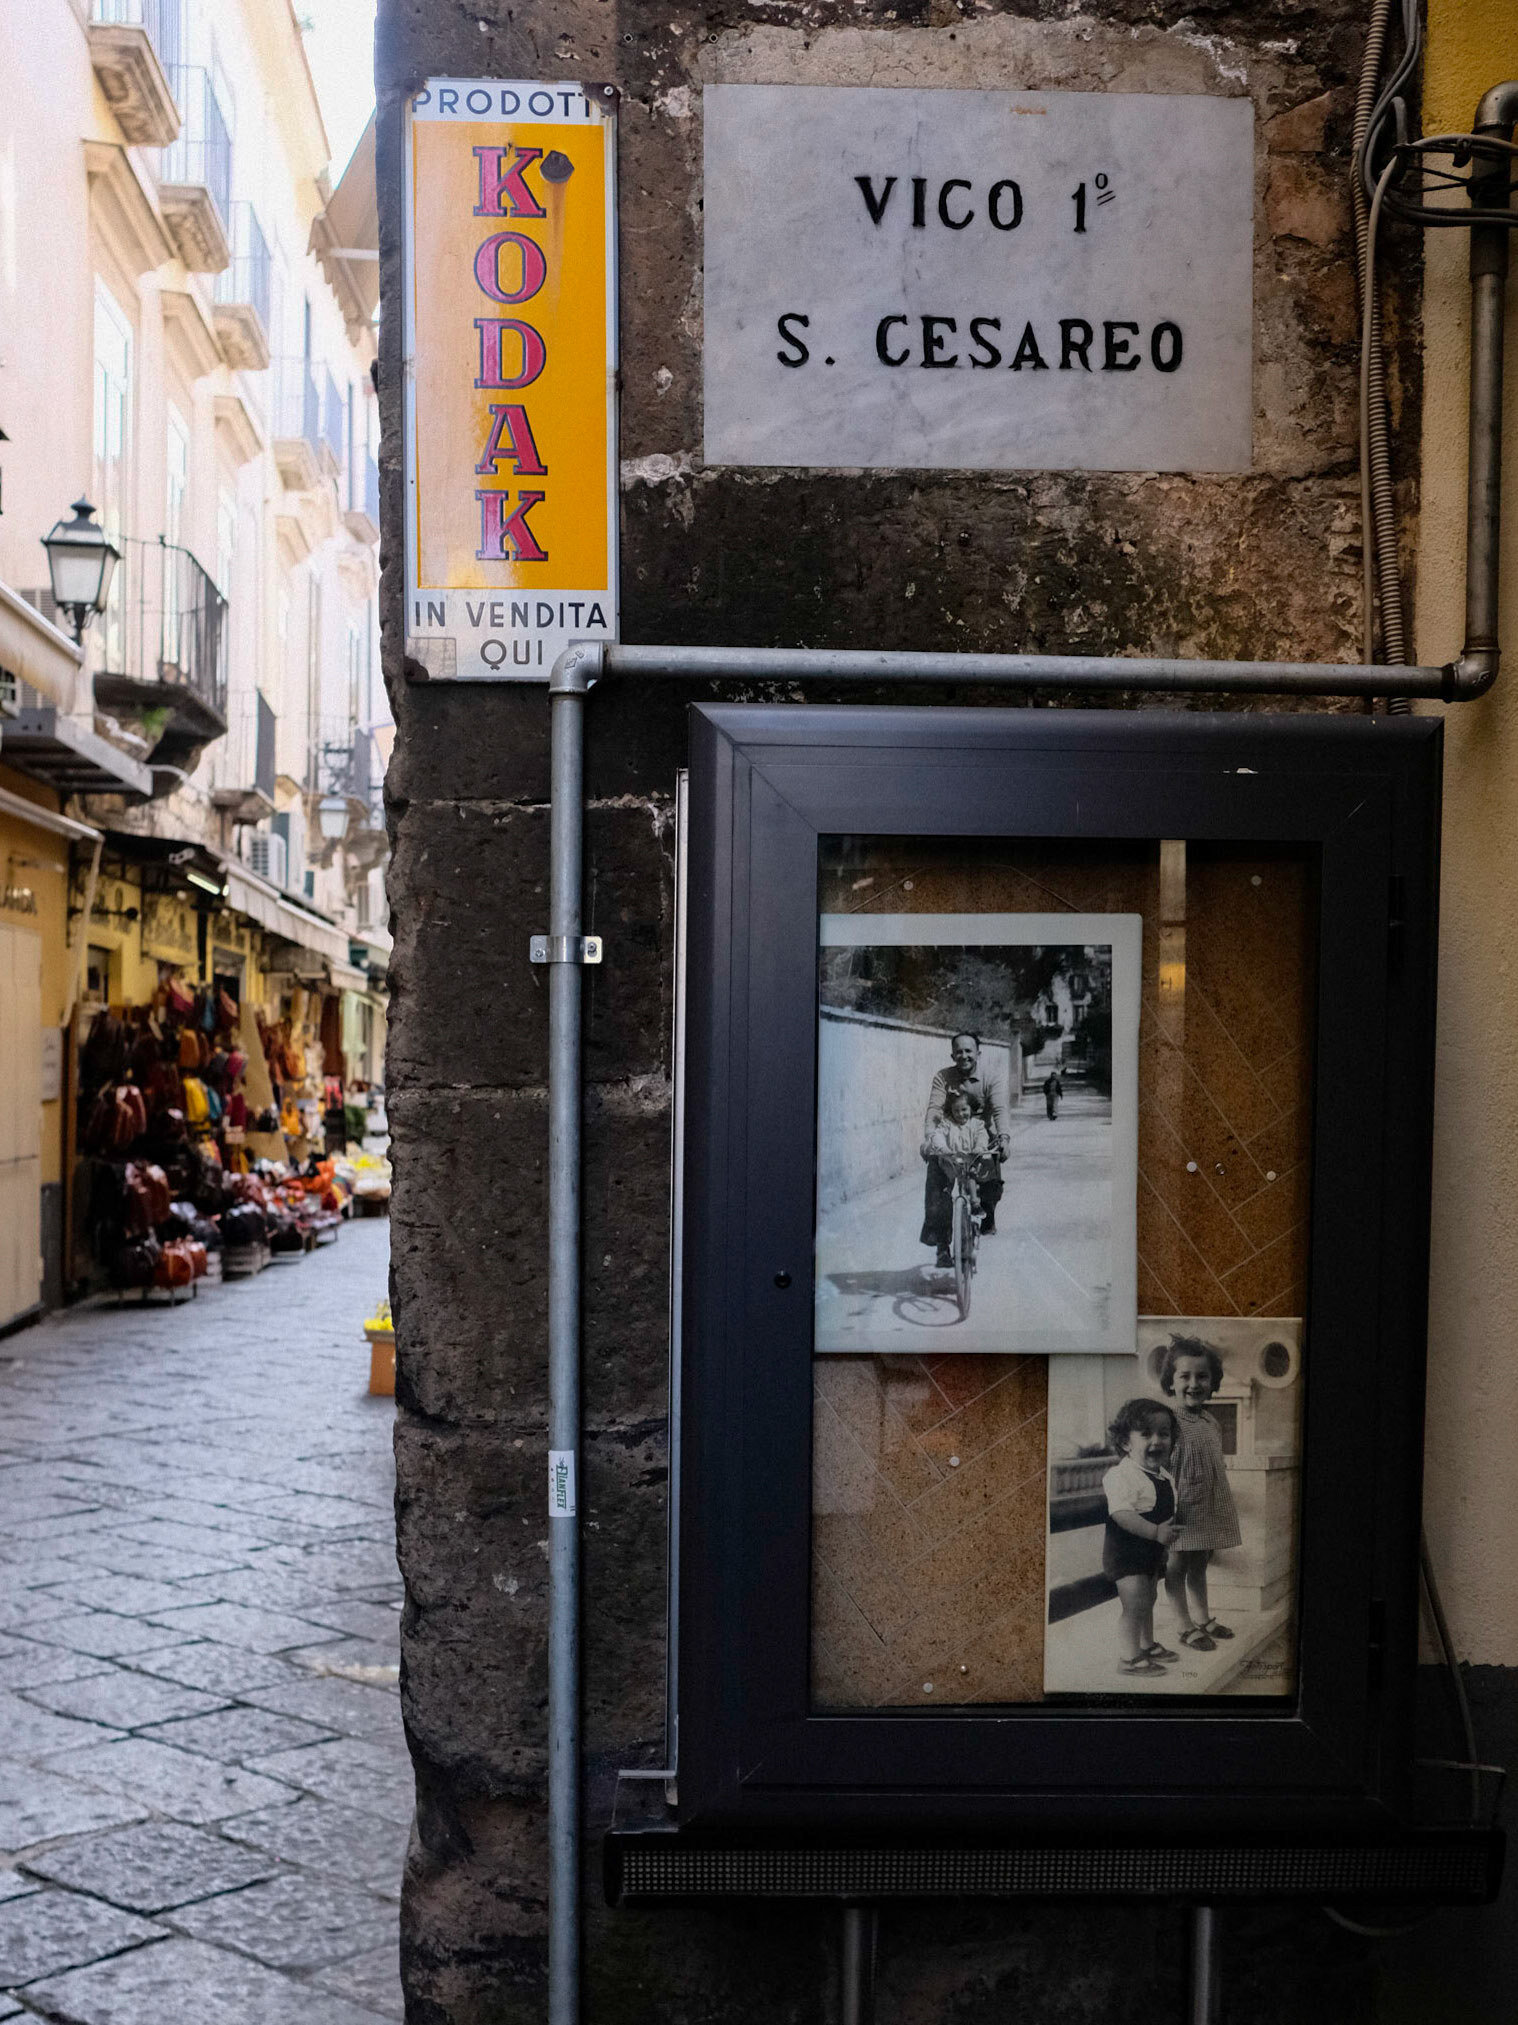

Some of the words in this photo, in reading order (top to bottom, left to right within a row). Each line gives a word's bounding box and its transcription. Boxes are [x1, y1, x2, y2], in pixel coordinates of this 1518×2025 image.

[411, 88, 605, 118] PRODOTT
[854, 175, 1024, 231] VICO
[472, 145, 548, 562] KODAK
[777, 313, 836, 368] S.
[875, 315, 1183, 373] CESAREO
[415, 601, 446, 628] IN
[465, 601, 608, 629] VENDITA
[480, 638, 543, 671] QUI
